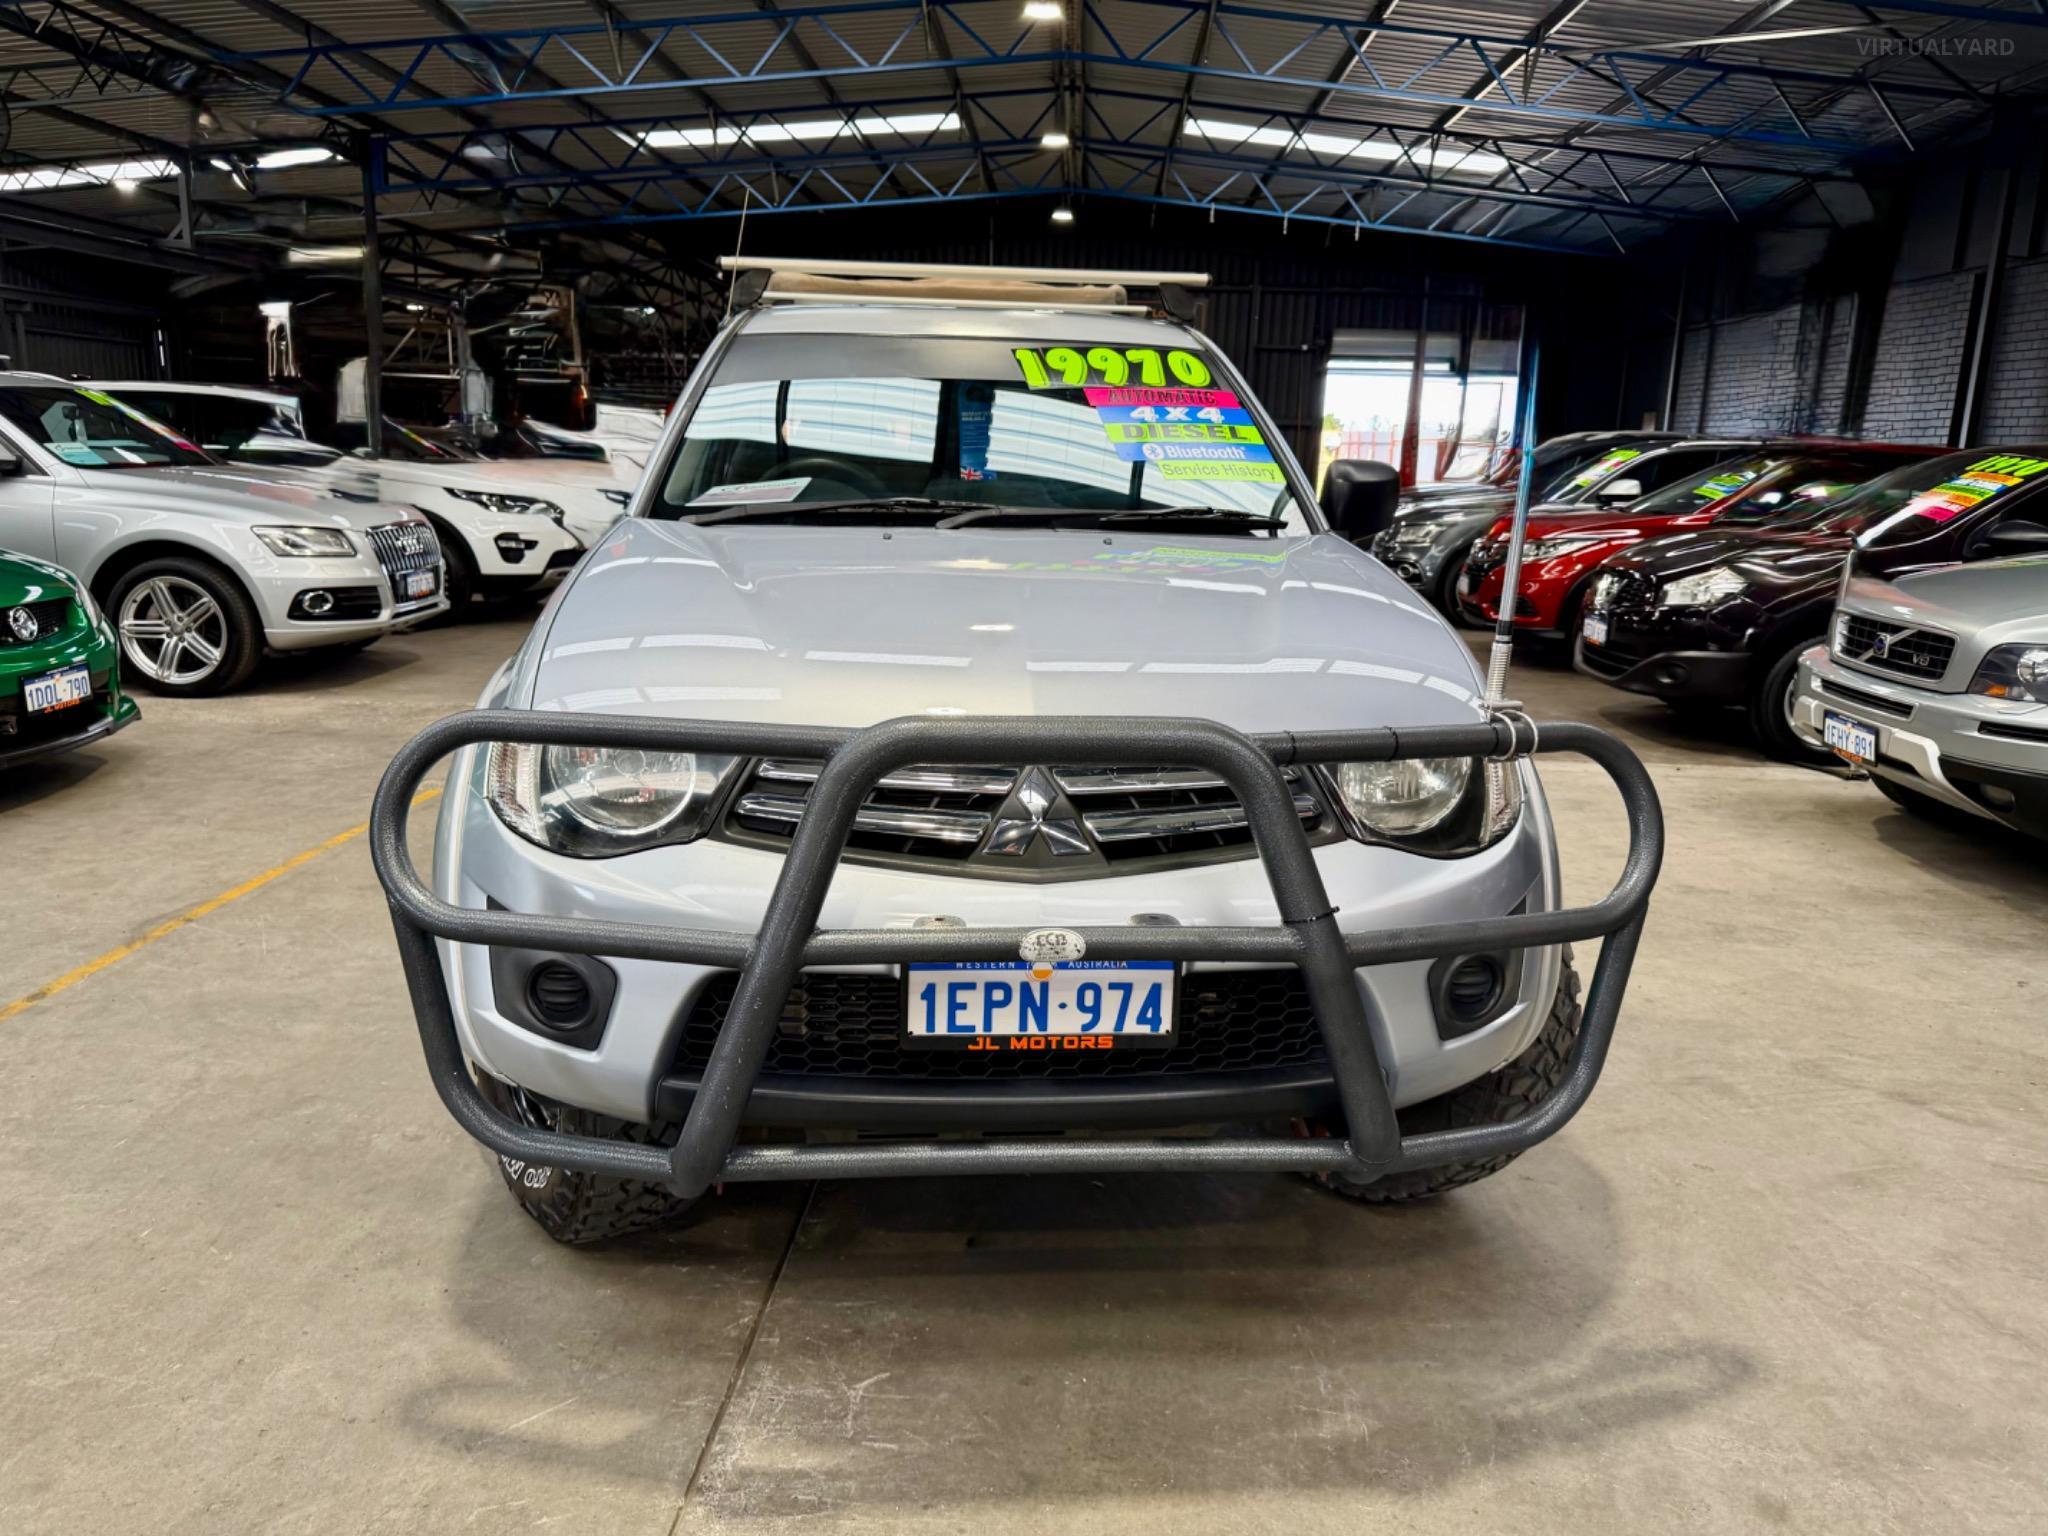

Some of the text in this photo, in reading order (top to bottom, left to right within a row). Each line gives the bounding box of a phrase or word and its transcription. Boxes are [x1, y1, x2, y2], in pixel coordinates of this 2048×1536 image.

[1014, 347, 1212, 387] 19970
[1108, 388, 1217, 406] AUTOMATIC
[1123, 423, 1248, 441] DIESEL
[1167, 444, 1246, 460] Bluetooth
[1162, 462, 1276, 480] Service History
[967, 1035, 1114, 1050] JL MOTORS
